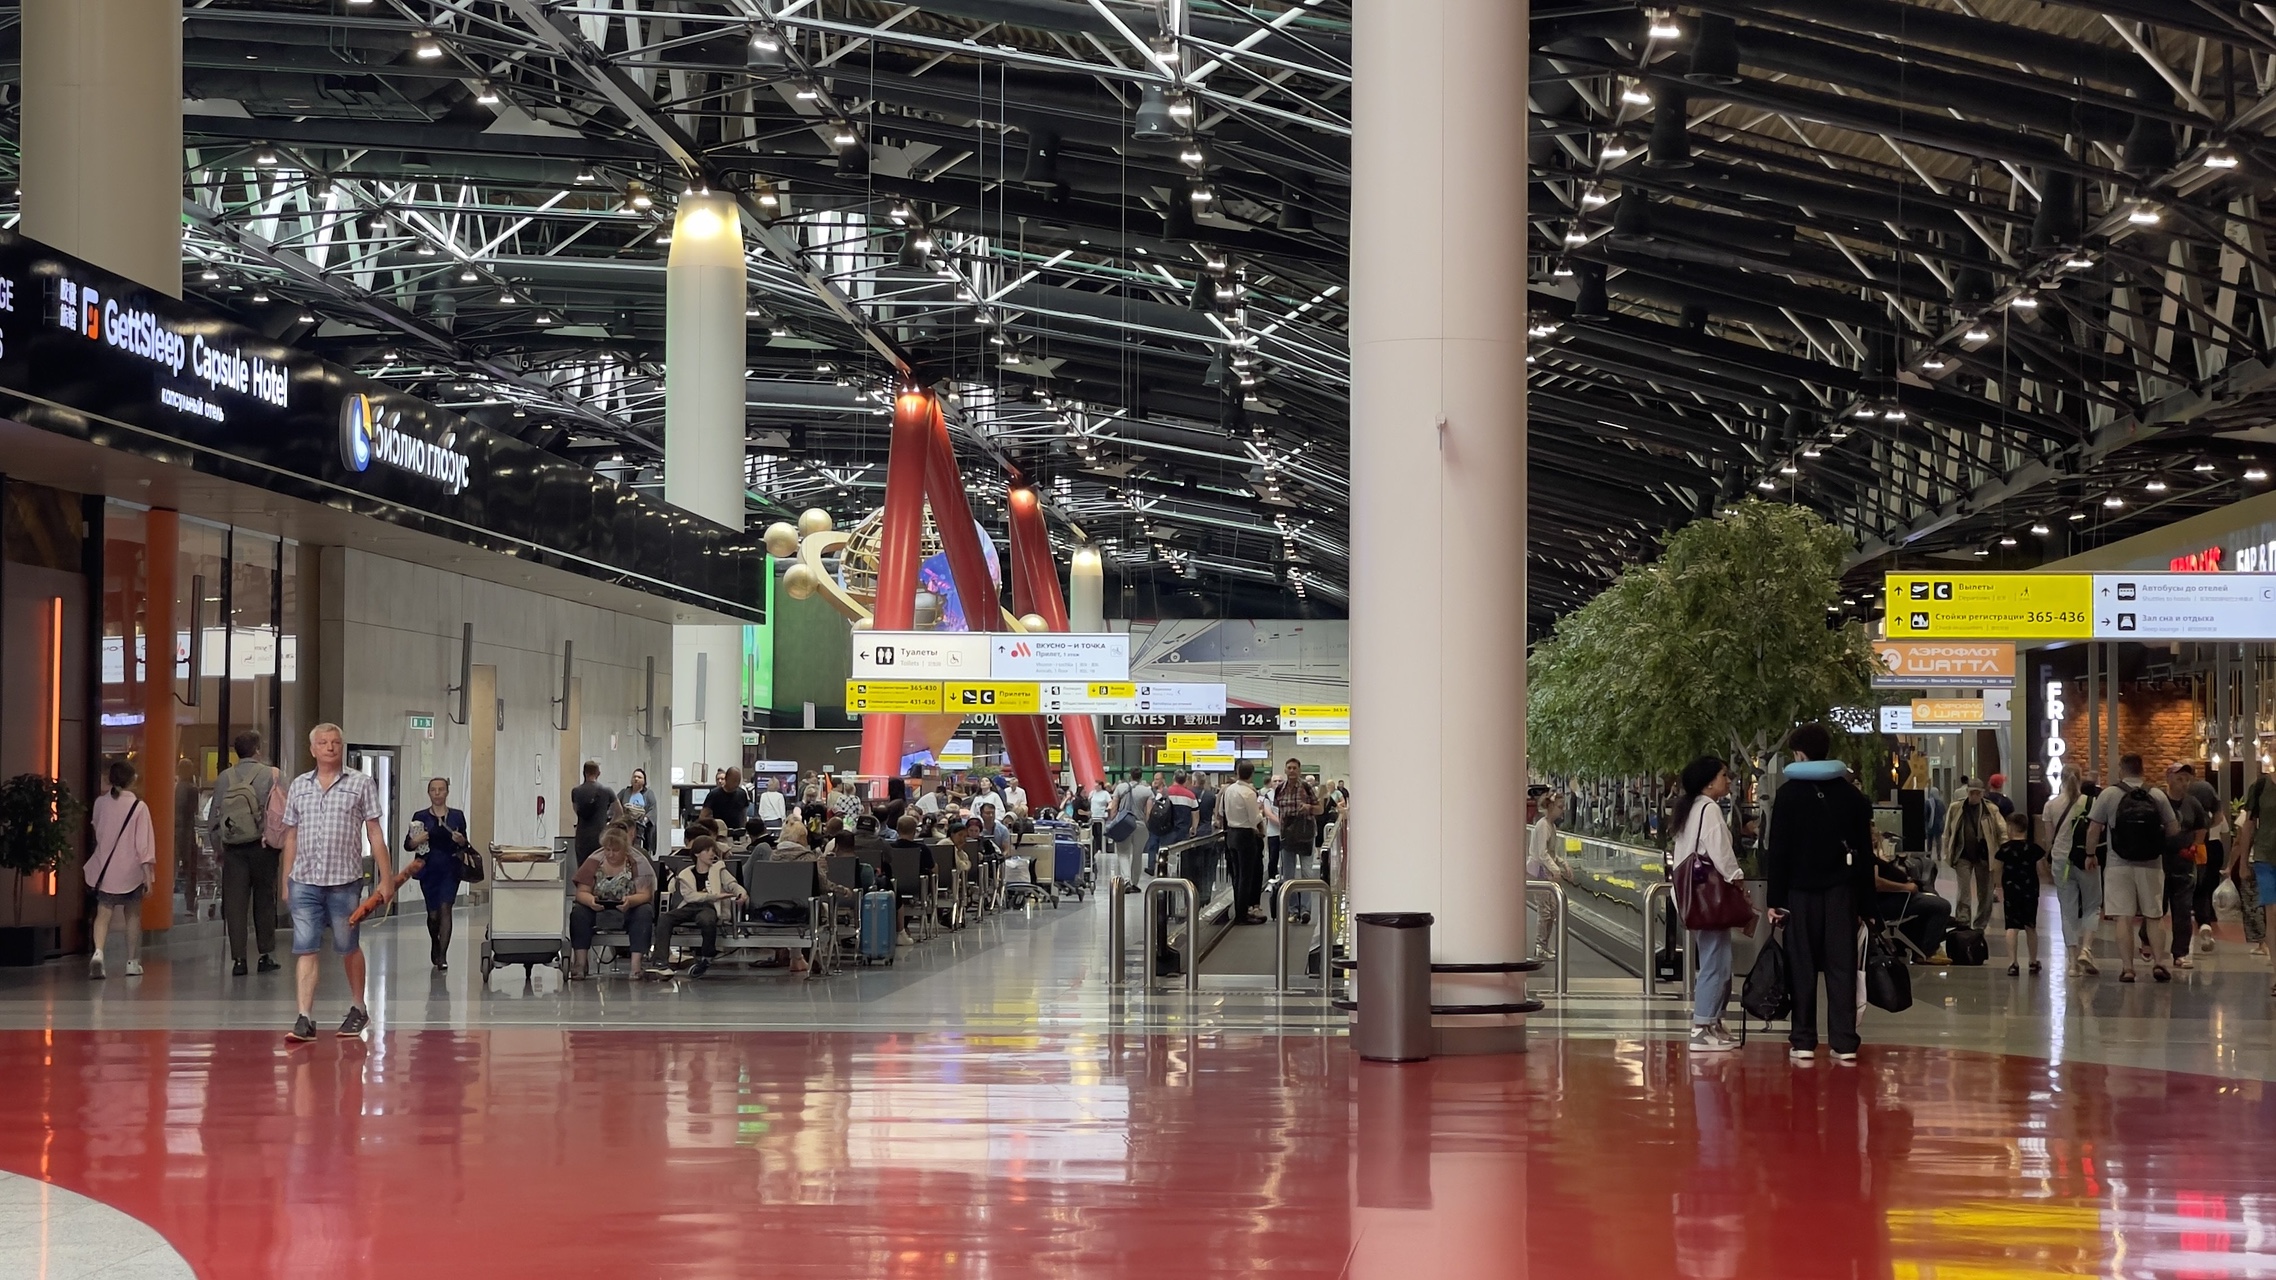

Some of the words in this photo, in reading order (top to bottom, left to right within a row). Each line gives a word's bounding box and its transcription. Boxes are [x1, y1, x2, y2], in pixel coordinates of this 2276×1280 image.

[104, 298, 186, 378] GettSleep
[192, 333, 250, 391] Capsule
[252, 355, 289, 408] Hotel
[204, 401, 225, 422] отель
[1958, 583, 1994, 591] Вылеты
[2142, 584, 2184, 593] Автобусы
[2185, 585, 2197, 593] до
[2198, 583, 2228, 592] отелей
[1935, 612, 1967, 621] Стойки
[1968, 614, 2025, 623] регистрации
[2027, 611, 2085, 623] 365-436
[900, 648, 938, 657] Туалеты
[1908, 647, 2000, 656] АЭРОФЛОТ
[1907, 659, 2000, 672] ШАТТЛ
[1121, 714, 1166, 725] GATES
[1240, 714, 1264, 725] 124
[2046, 681, 2066, 801] FRIDAY
